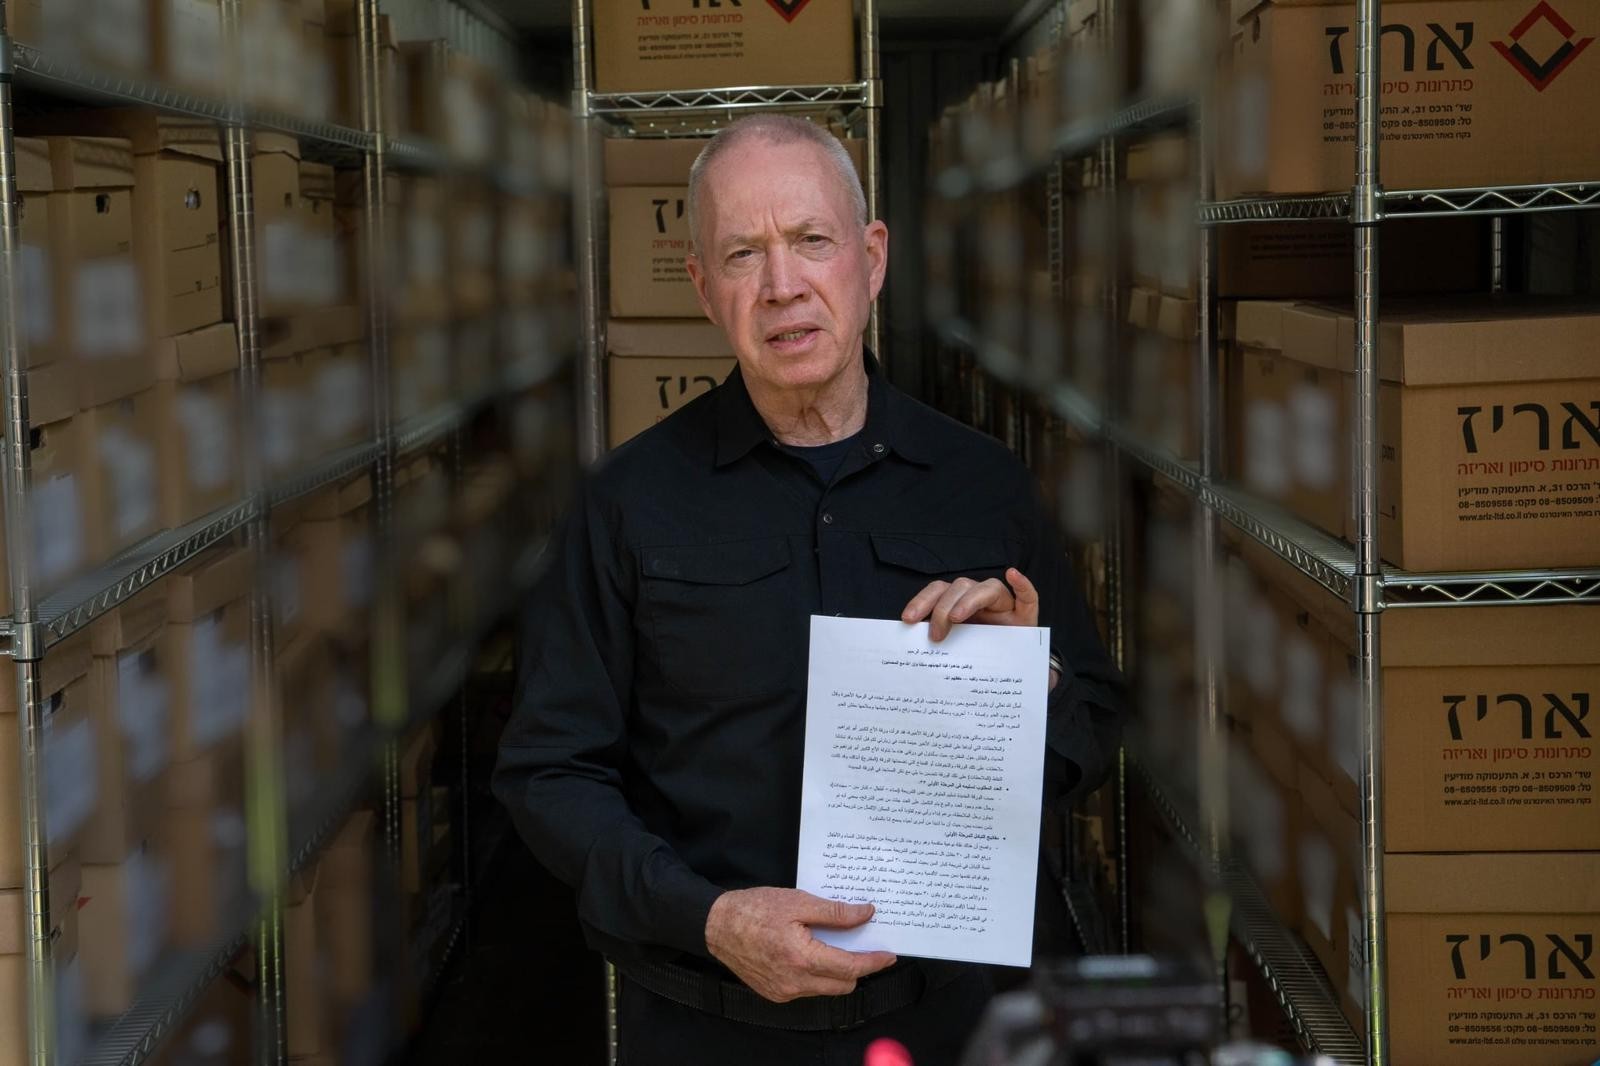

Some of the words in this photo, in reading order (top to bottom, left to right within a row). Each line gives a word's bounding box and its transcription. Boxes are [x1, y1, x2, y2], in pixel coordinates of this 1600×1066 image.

[1324, 22, 1474, 74] ארז
[1381, 81, 1409, 94] סימ
[1415, 79, 1474, 93] פתרונות
[1429, 104, 1453, 113] הרכס
[1457, 463, 1504, 475] ואריזה
[1509, 460, 1545, 476] סימון
[1551, 458, 1600, 472] תרונות
[1458, 487, 1489, 497] מודיעין
[1491, 486, 1535, 496] התעסוקה
[1566, 483, 1590, 492] הרכס
[1442, 692, 1592, 740] אריז
[1442, 748, 1488, 760] ואריזה
[1493, 748, 1528, 763] סימון
[1533, 746, 1592, 759] פתרונות
[1445, 934, 1595, 979] אריז
[1448, 988, 1491, 999] ואריזה
[1496, 988, 1532, 1002] סימון
[1538, 987, 1595, 1000] פתרונות
